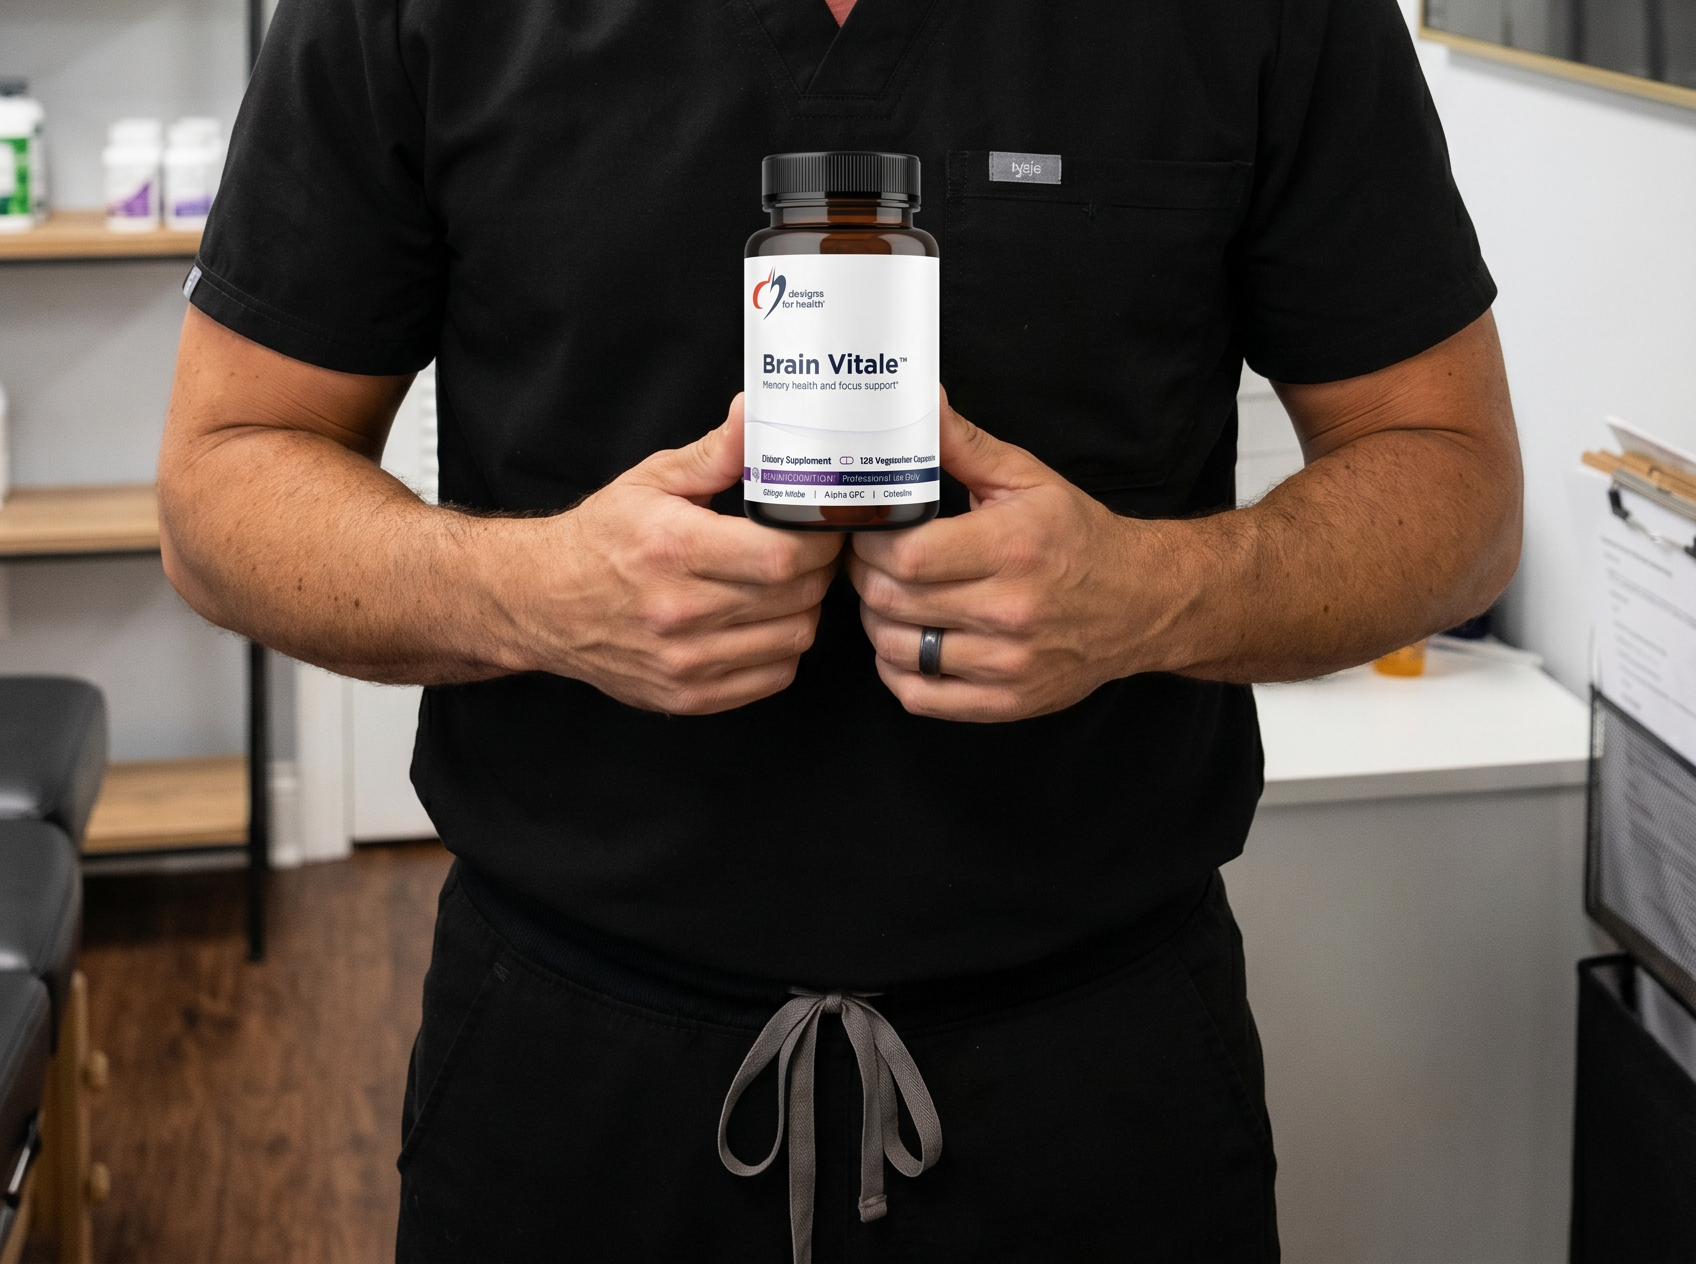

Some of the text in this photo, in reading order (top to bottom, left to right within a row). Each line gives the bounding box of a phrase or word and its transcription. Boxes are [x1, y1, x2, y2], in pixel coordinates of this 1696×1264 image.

[782, 299, 825, 309] for health
[763, 353, 820, 375] Brain
[819, 380, 837, 390] and
[838, 380, 862, 391] focus
[859, 456, 874, 465] 128
[849, 490, 865, 499] GPC
